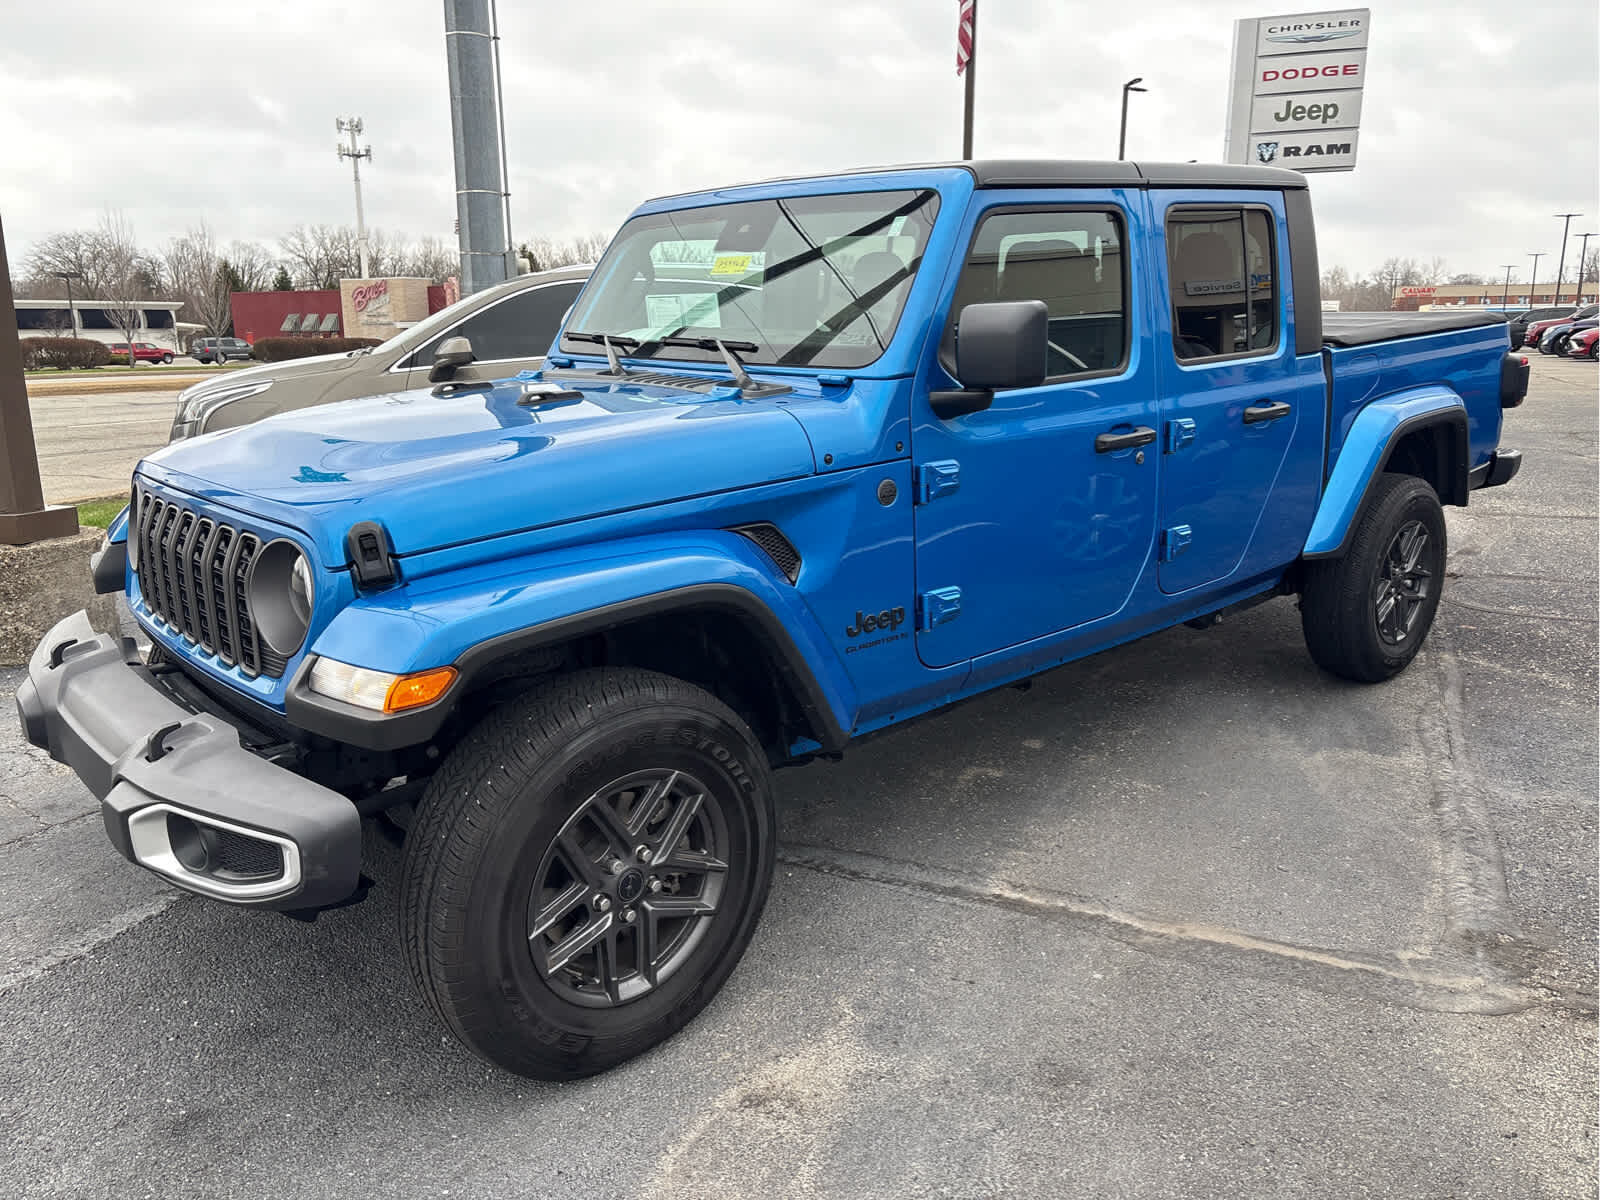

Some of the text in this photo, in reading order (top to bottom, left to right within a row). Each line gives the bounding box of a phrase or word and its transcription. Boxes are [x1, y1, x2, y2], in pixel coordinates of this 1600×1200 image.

[1268, 20, 1361, 34] CHRYSLER
[1262, 64, 1360, 82] DODGE
[1274, 100, 1340, 124] Jeep
[1283, 143, 1352, 158] RAM
[846, 606, 905, 638] Jeep
